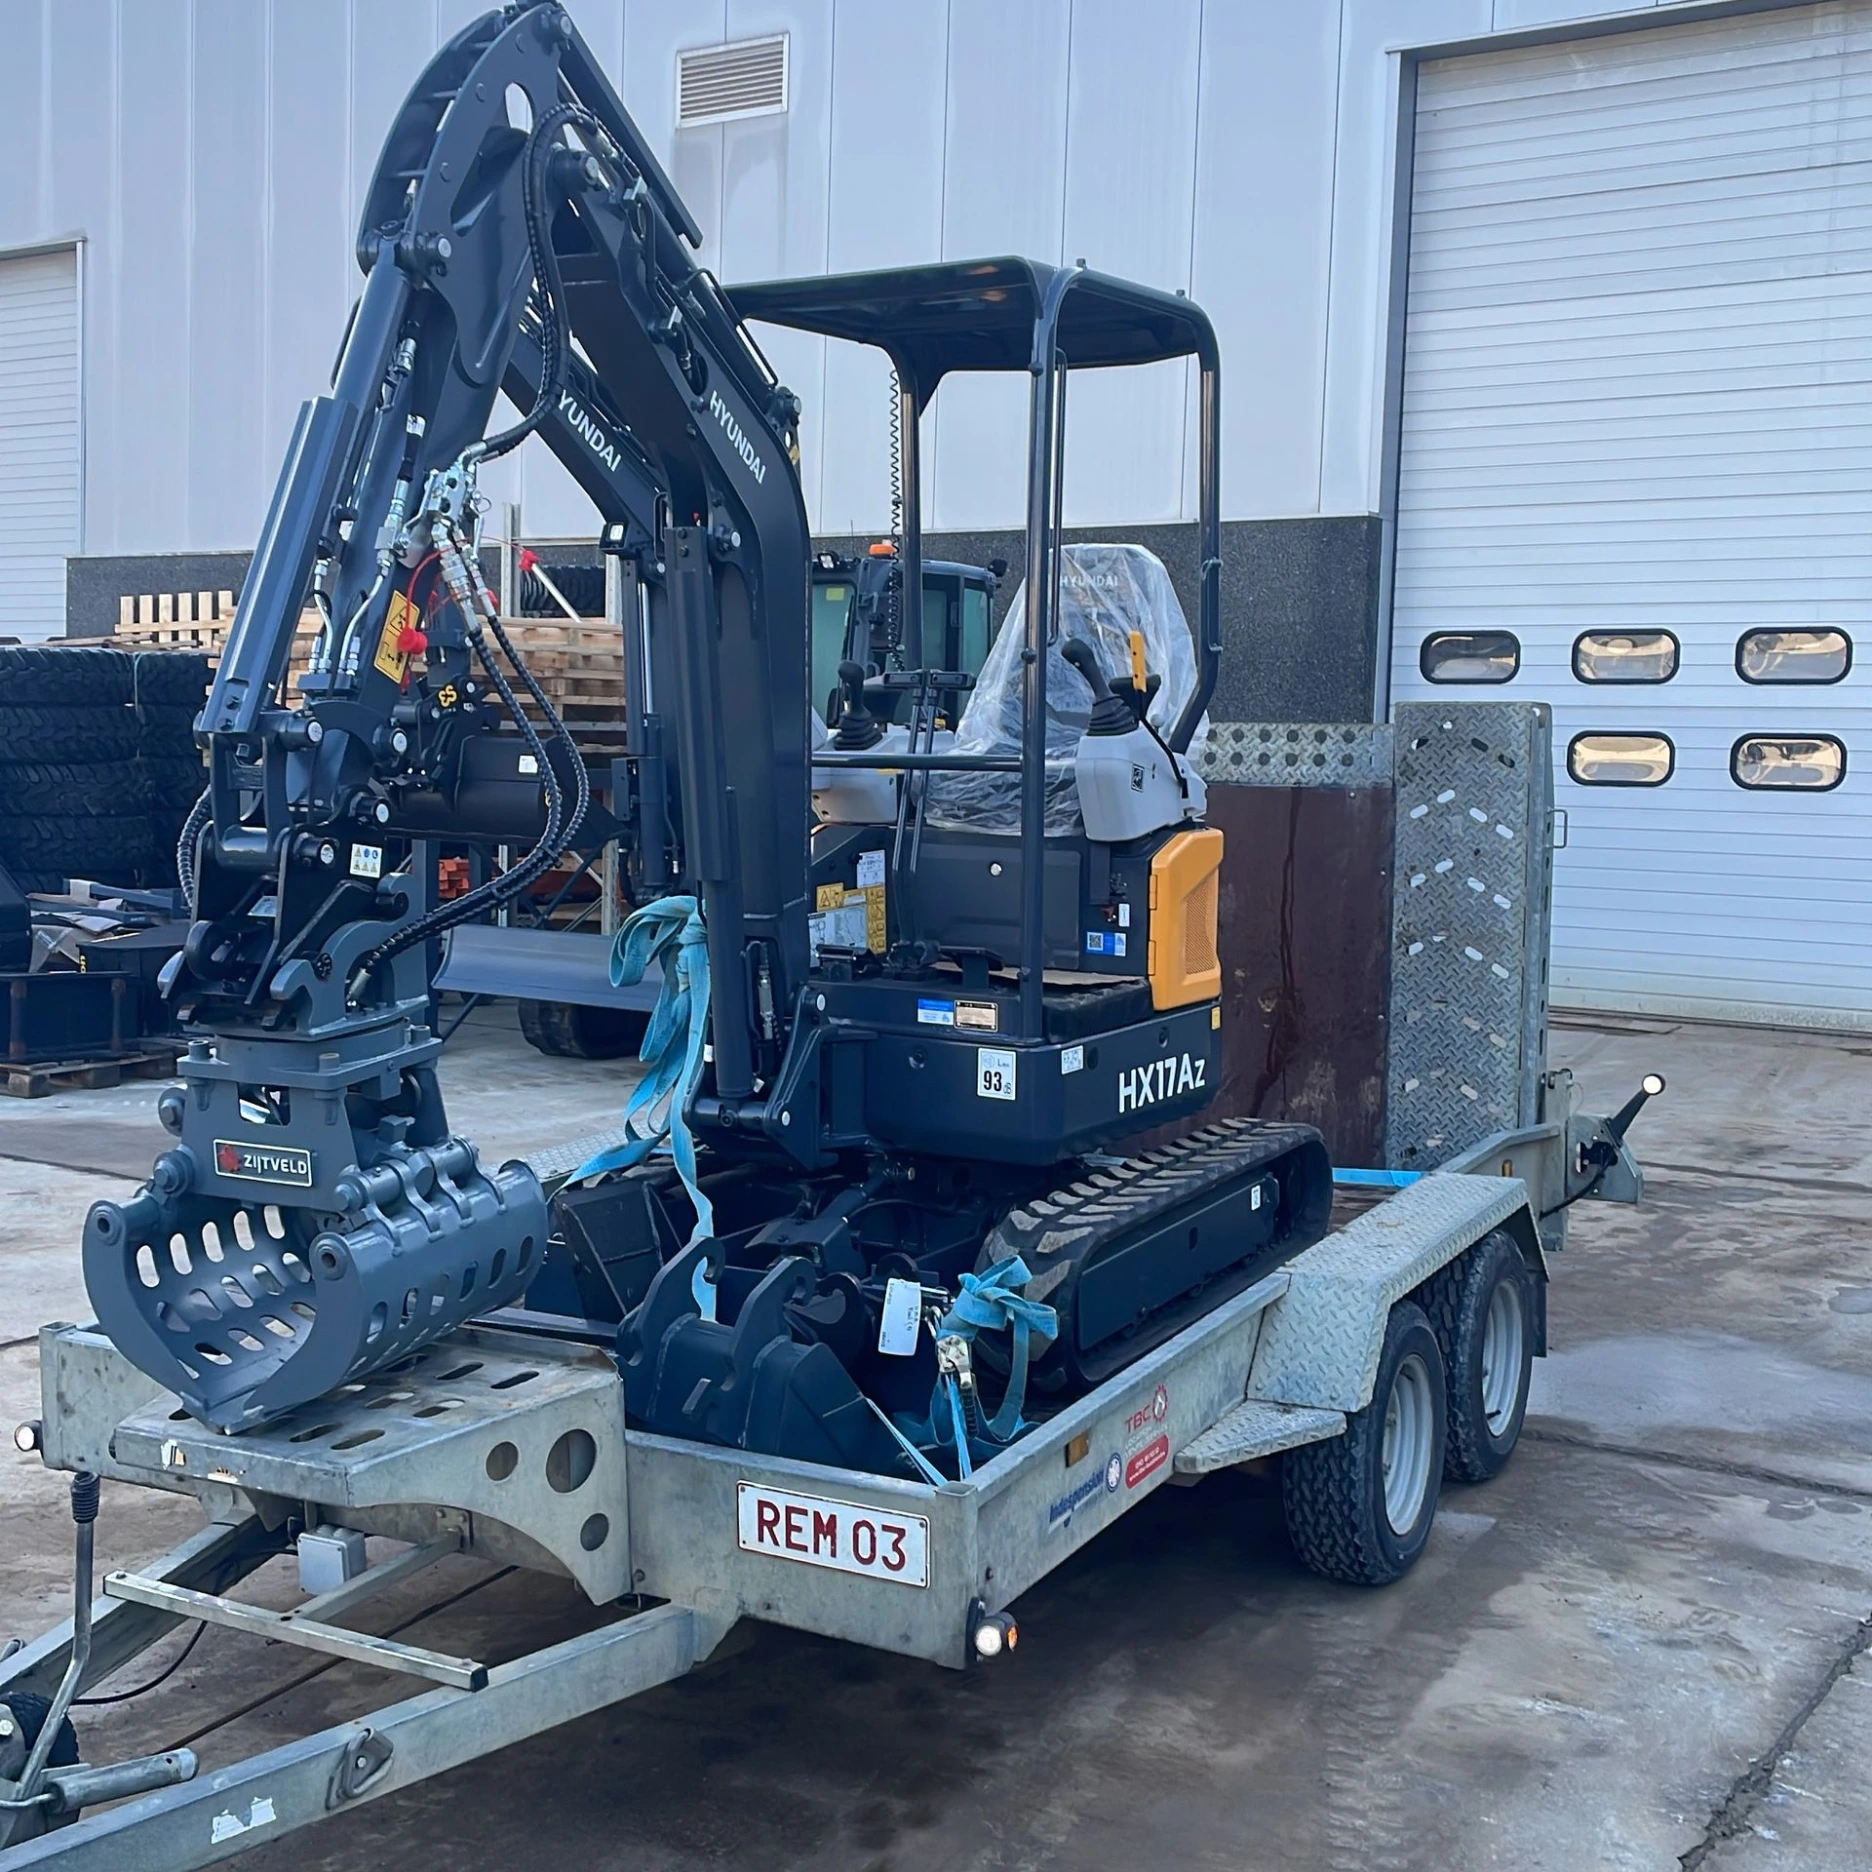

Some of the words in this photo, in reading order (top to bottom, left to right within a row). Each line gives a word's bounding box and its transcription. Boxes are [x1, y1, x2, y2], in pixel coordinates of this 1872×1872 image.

[556, 389, 622, 472] YUNDAI
[709, 390, 766, 484] HYUNDAI
[1060, 575, 1118, 588] HYUNDAI
[983, 1070, 1002, 1092] 93
[243, 1154, 307, 1175] ZIJTVELD
[1125, 1404, 1152, 1433] TBC
[757, 1499, 838, 1558] REM
[852, 1519, 907, 1572] 03
